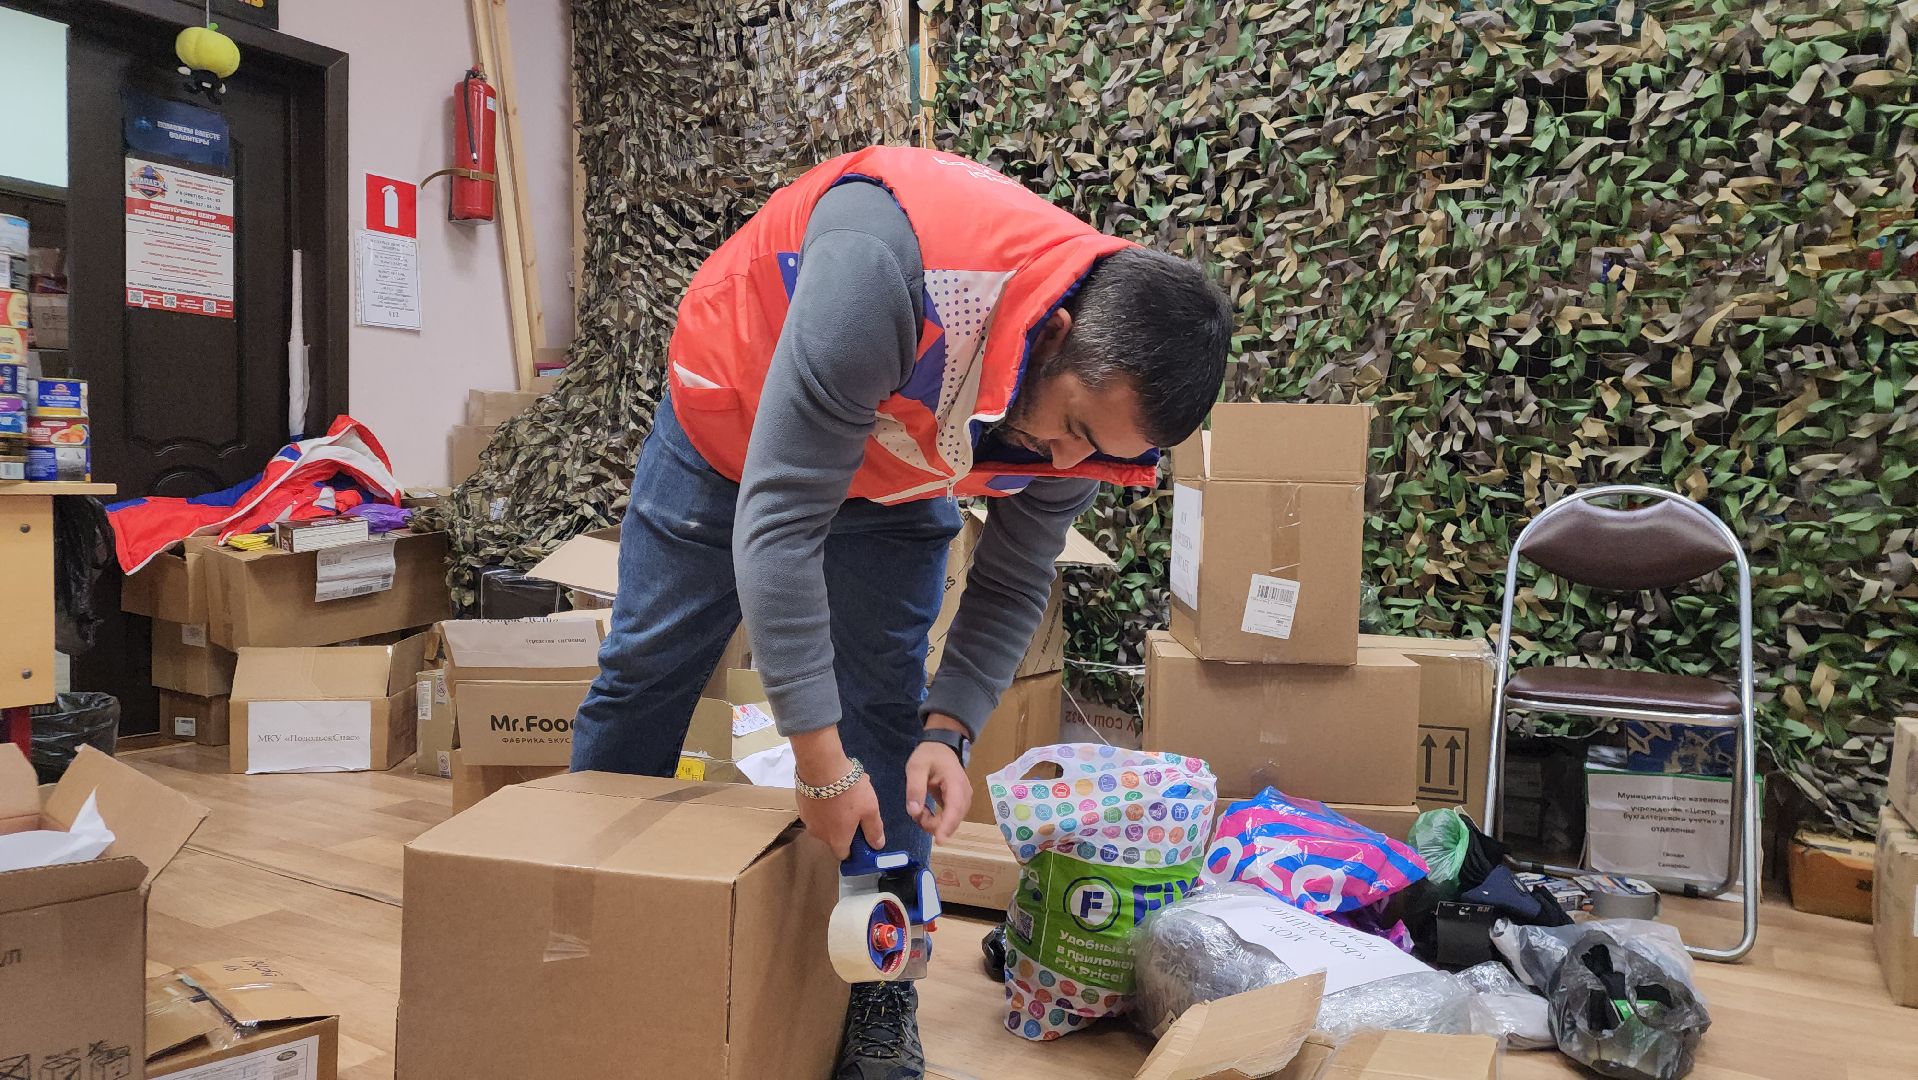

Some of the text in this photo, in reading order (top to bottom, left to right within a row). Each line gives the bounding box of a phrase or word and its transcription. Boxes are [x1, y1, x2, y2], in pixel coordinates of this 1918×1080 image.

[490, 714, 575, 733] Mr.Foo
[1093, 714, 1123, 730] СОШ
[257, 733, 282, 743] МКУ
[1617, 791, 1687, 802] Муниципальное
[1630, 805, 1683, 813] учреждение
[1650, 826, 1697, 834] отделение
[1079, 890, 1105, 919] F
[1059, 930, 1124, 954] Удобные
[1056, 945, 1065, 954] в
